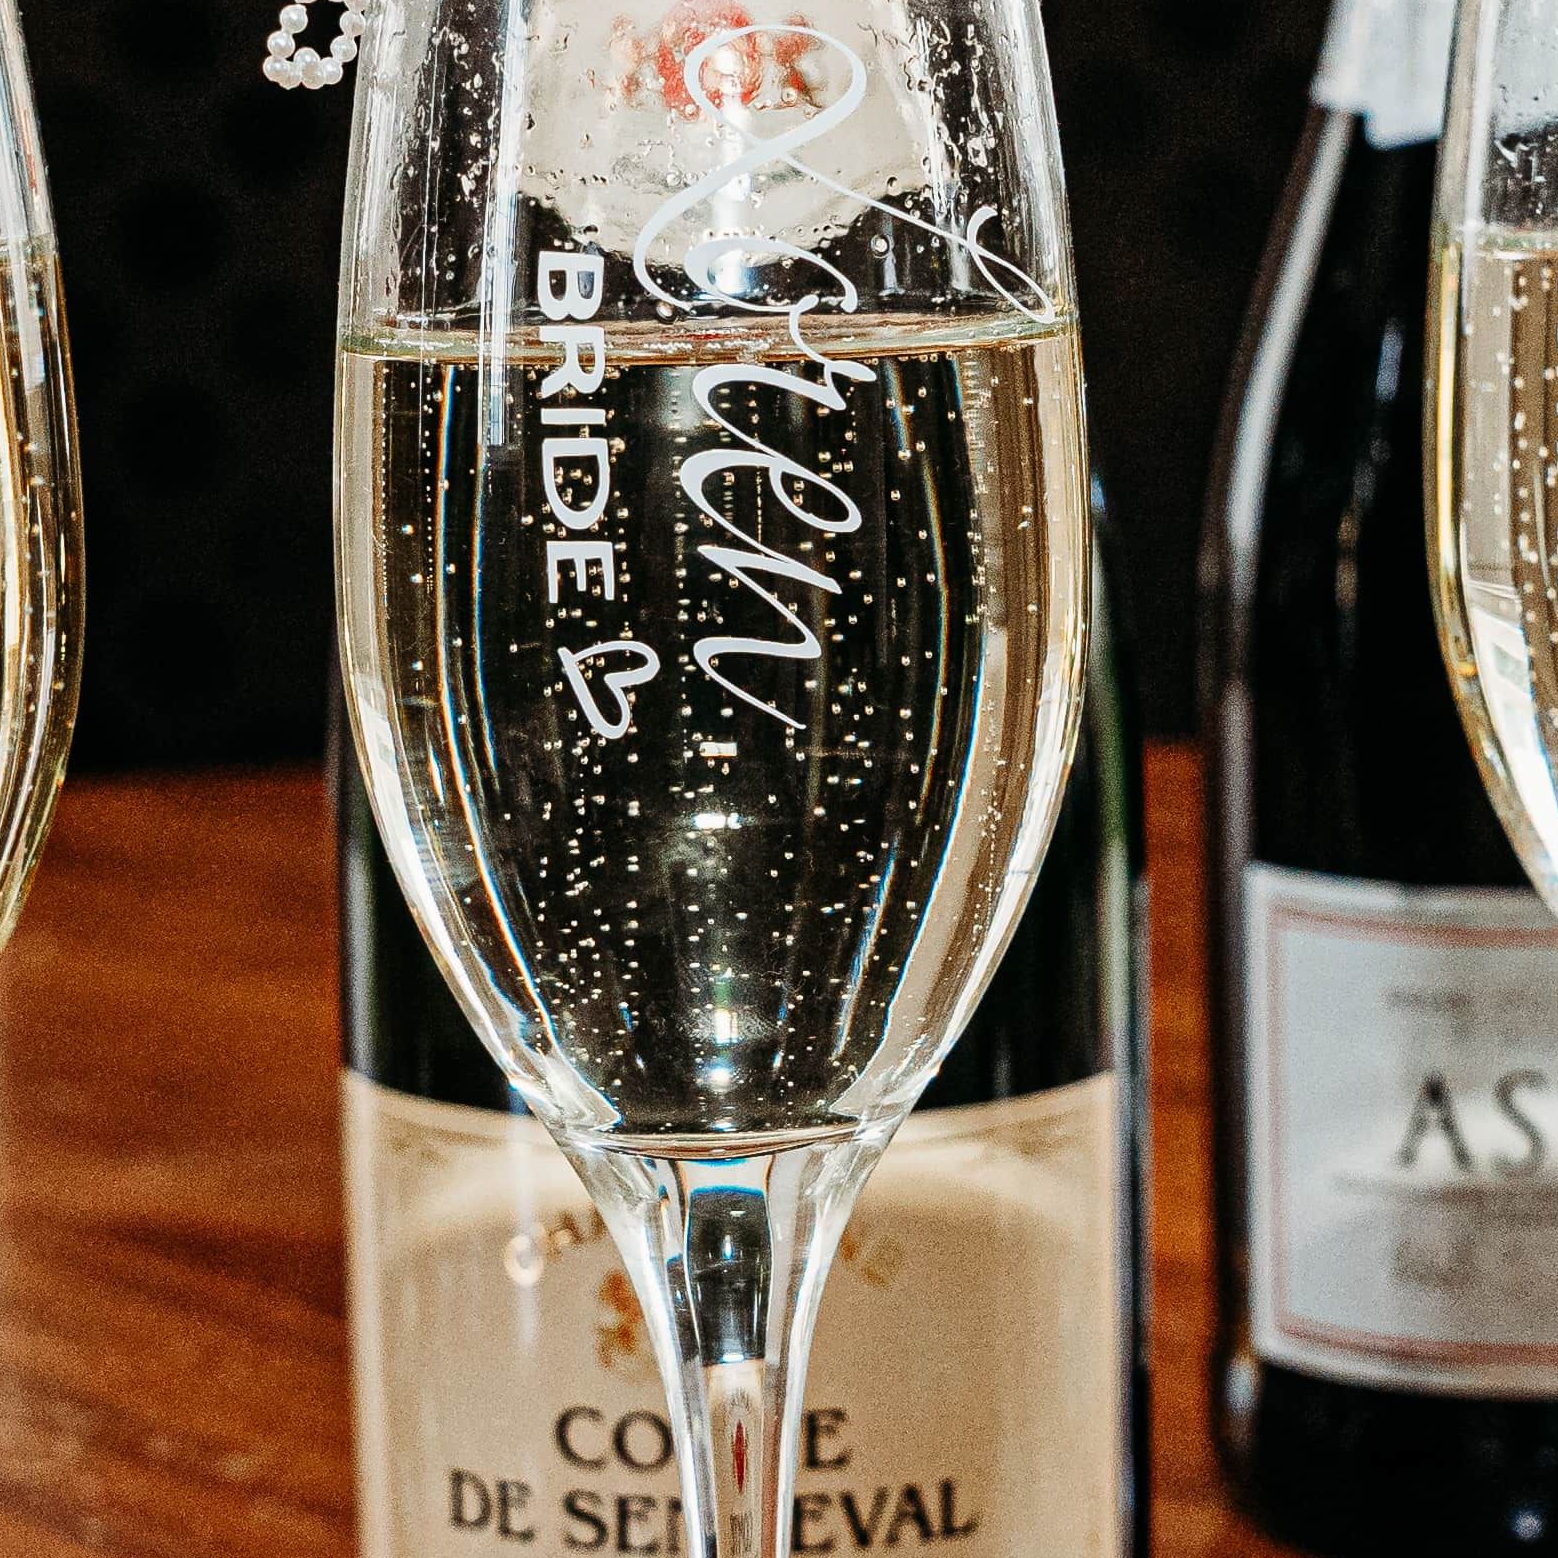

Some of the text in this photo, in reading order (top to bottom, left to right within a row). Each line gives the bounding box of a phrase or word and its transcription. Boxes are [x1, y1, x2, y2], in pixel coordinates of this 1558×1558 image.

[536, 250, 616, 604] BRIDE
[554, 1406, 852, 1471] COE
[449, 1467, 535, 1542] DE
